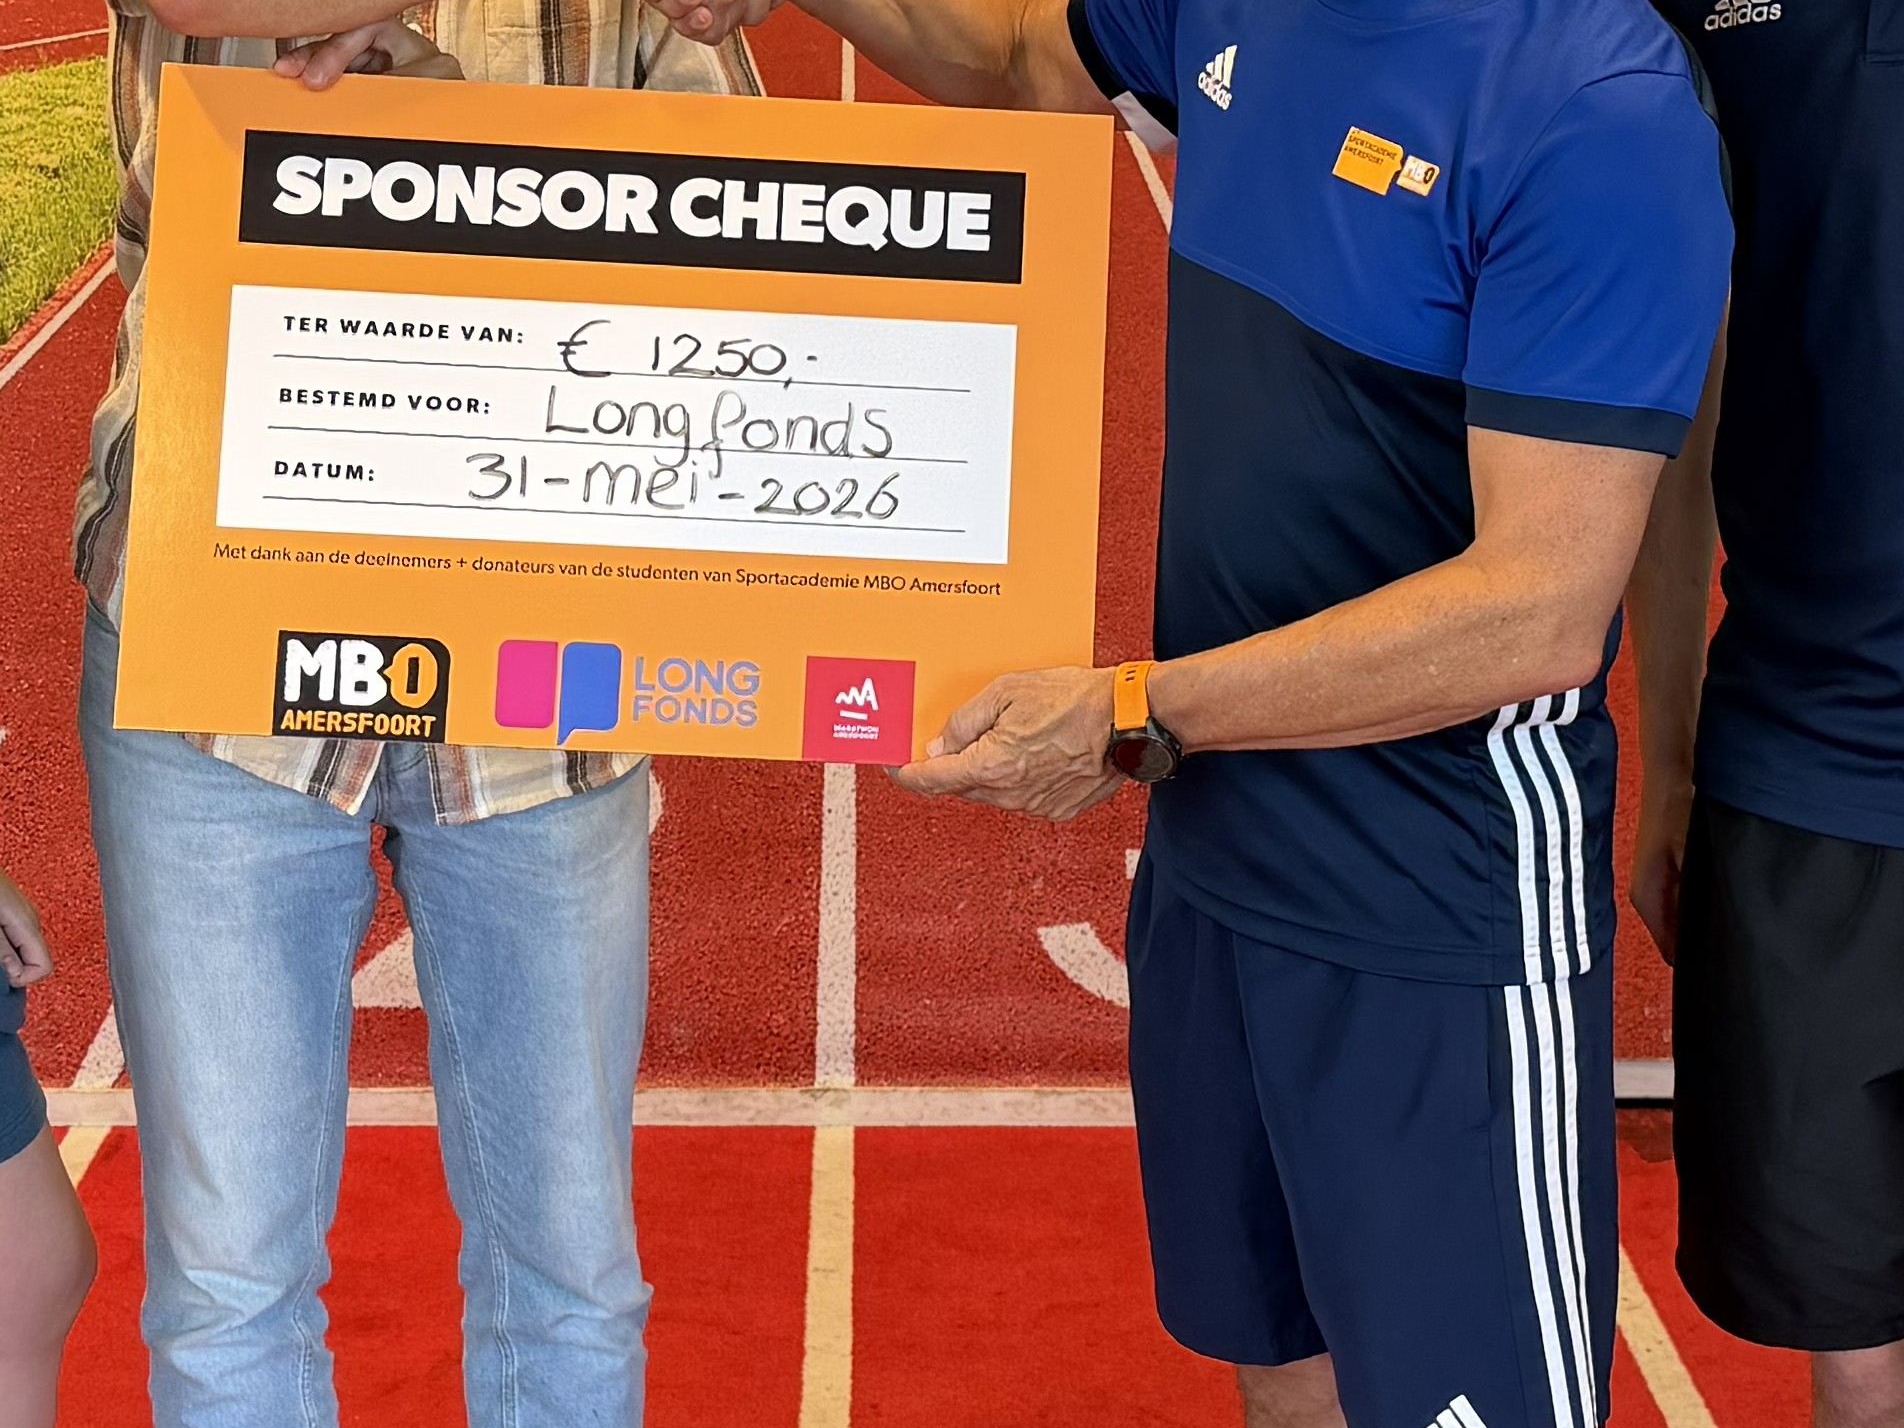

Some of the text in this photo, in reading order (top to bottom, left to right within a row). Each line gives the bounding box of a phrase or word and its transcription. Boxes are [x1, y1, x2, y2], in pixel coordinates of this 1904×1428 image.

[1704, 4, 1782, 31] adidas
[1198, 72, 1233, 110] adidas
[273, 156, 993, 252] SPONSOR CHEQUE
[283, 315, 524, 344] TER WAARDE VAN:
[558, 320, 612, 378] €
[279, 387, 491, 415] BESTEMD VOOR:
[274, 460, 376, 482] DATUM:
[213, 543, 1002, 597] Met dank aan de deelnemers + donateurs van de studenten van Sportacademie MBO Amersfoort
[283, 639, 439, 709] MBO
[633, 655, 760, 697] LONG
[280, 708, 438, 738] AMERSFOORT
[631, 694, 759, 728] FONDS
